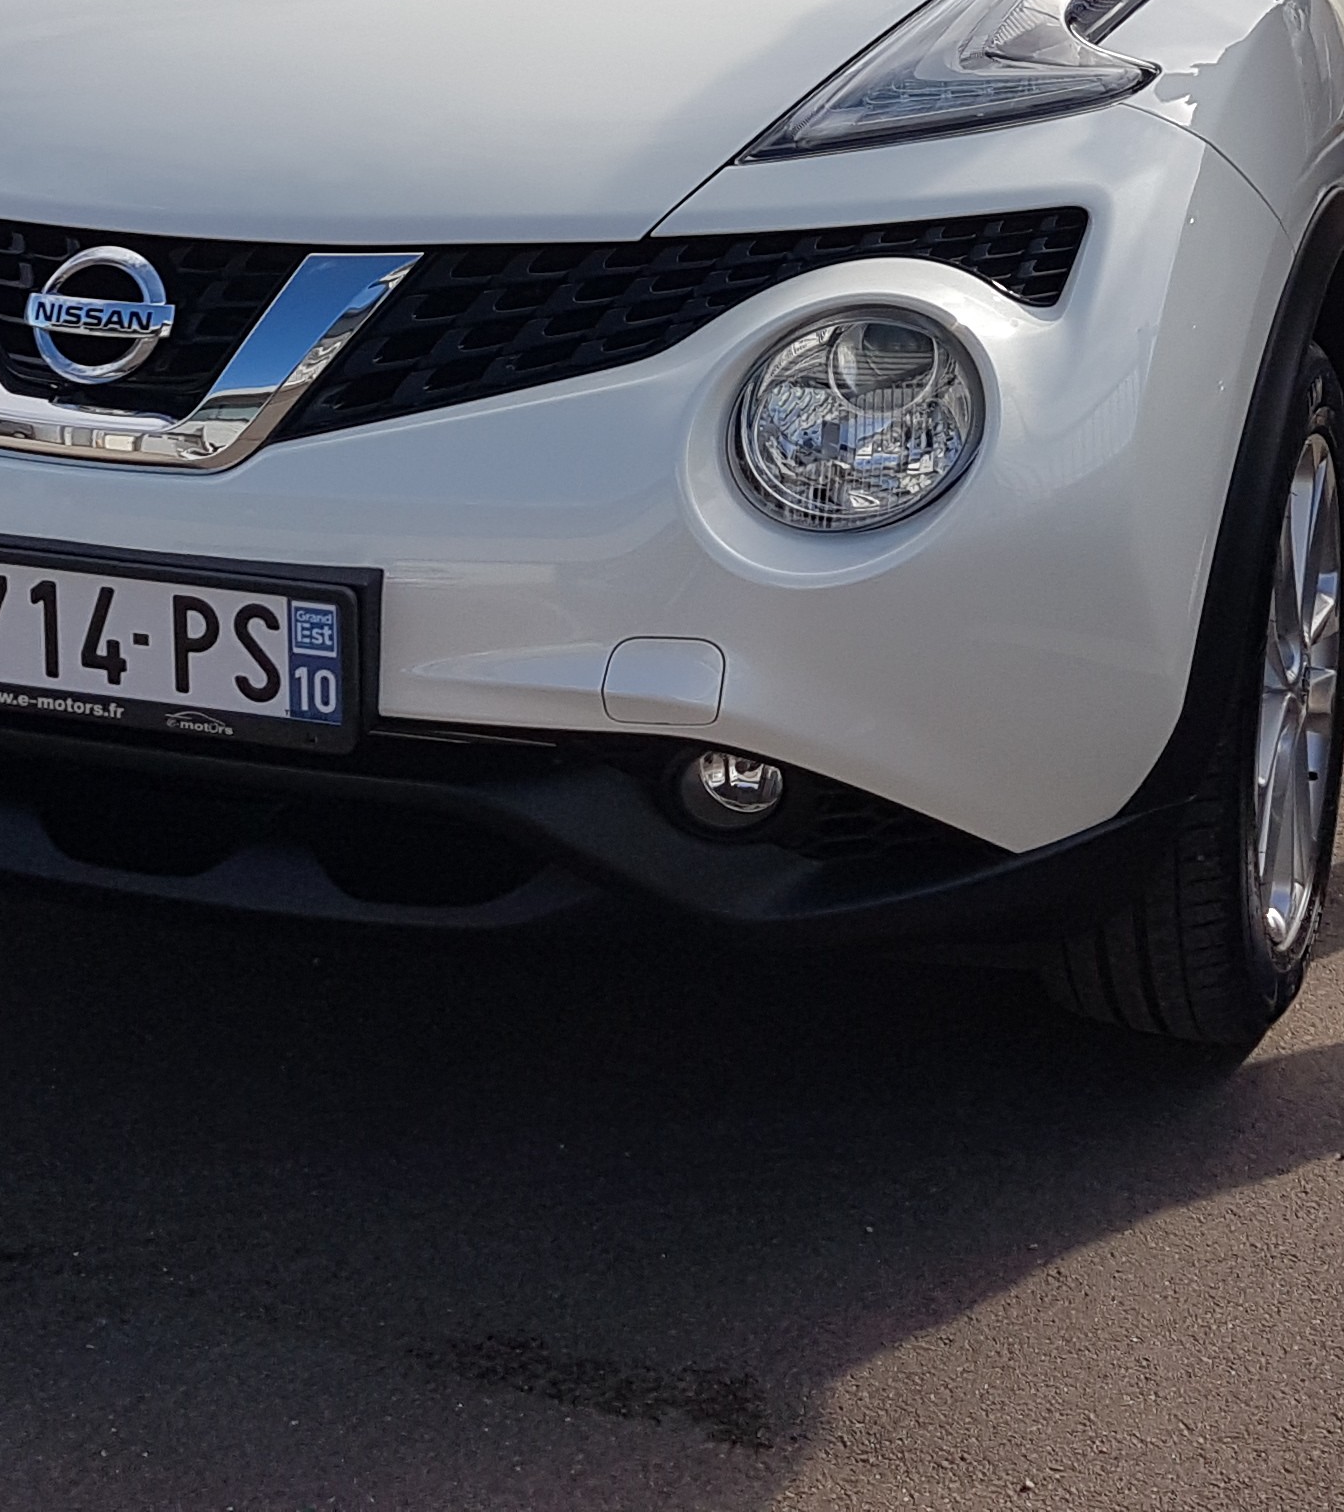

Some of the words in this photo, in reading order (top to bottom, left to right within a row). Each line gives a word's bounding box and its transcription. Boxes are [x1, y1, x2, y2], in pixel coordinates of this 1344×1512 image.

[35, 301, 154, 331] NISSAN
[296, 609, 333, 624] Grand
[296, 622, 334, 646] Est
[294, 665, 338, 714] 10
